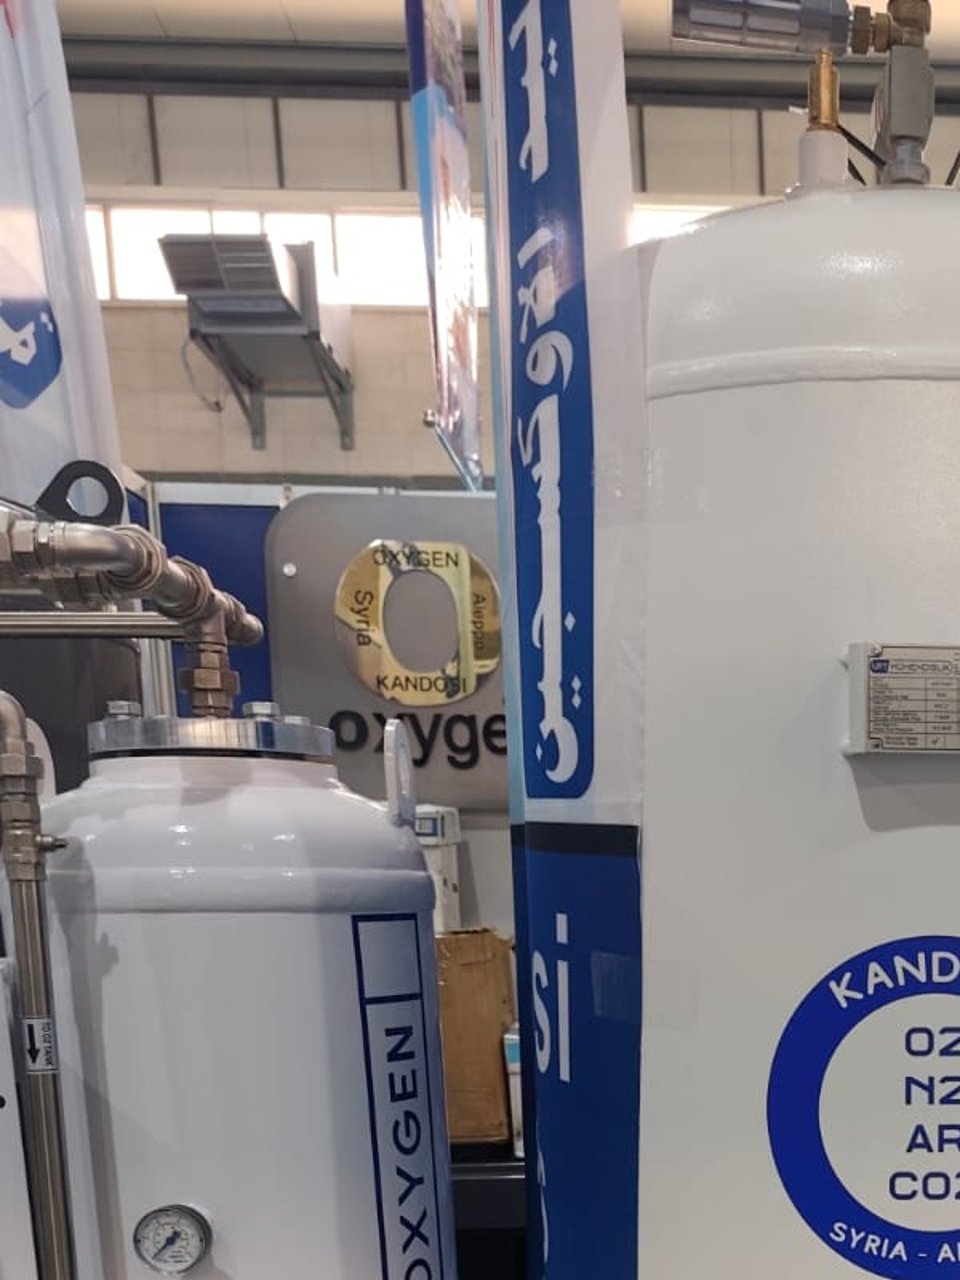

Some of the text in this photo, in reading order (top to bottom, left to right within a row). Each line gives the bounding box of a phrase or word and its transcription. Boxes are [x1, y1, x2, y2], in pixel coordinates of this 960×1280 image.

[372, 549, 459, 568] OXYGEN
[349, 589, 375, 648] Syria
[471, 592, 487, 650] Aleppo
[375, 674, 467, 694] KANDOSI
[828, 1221, 909, 1263] SYRIA
